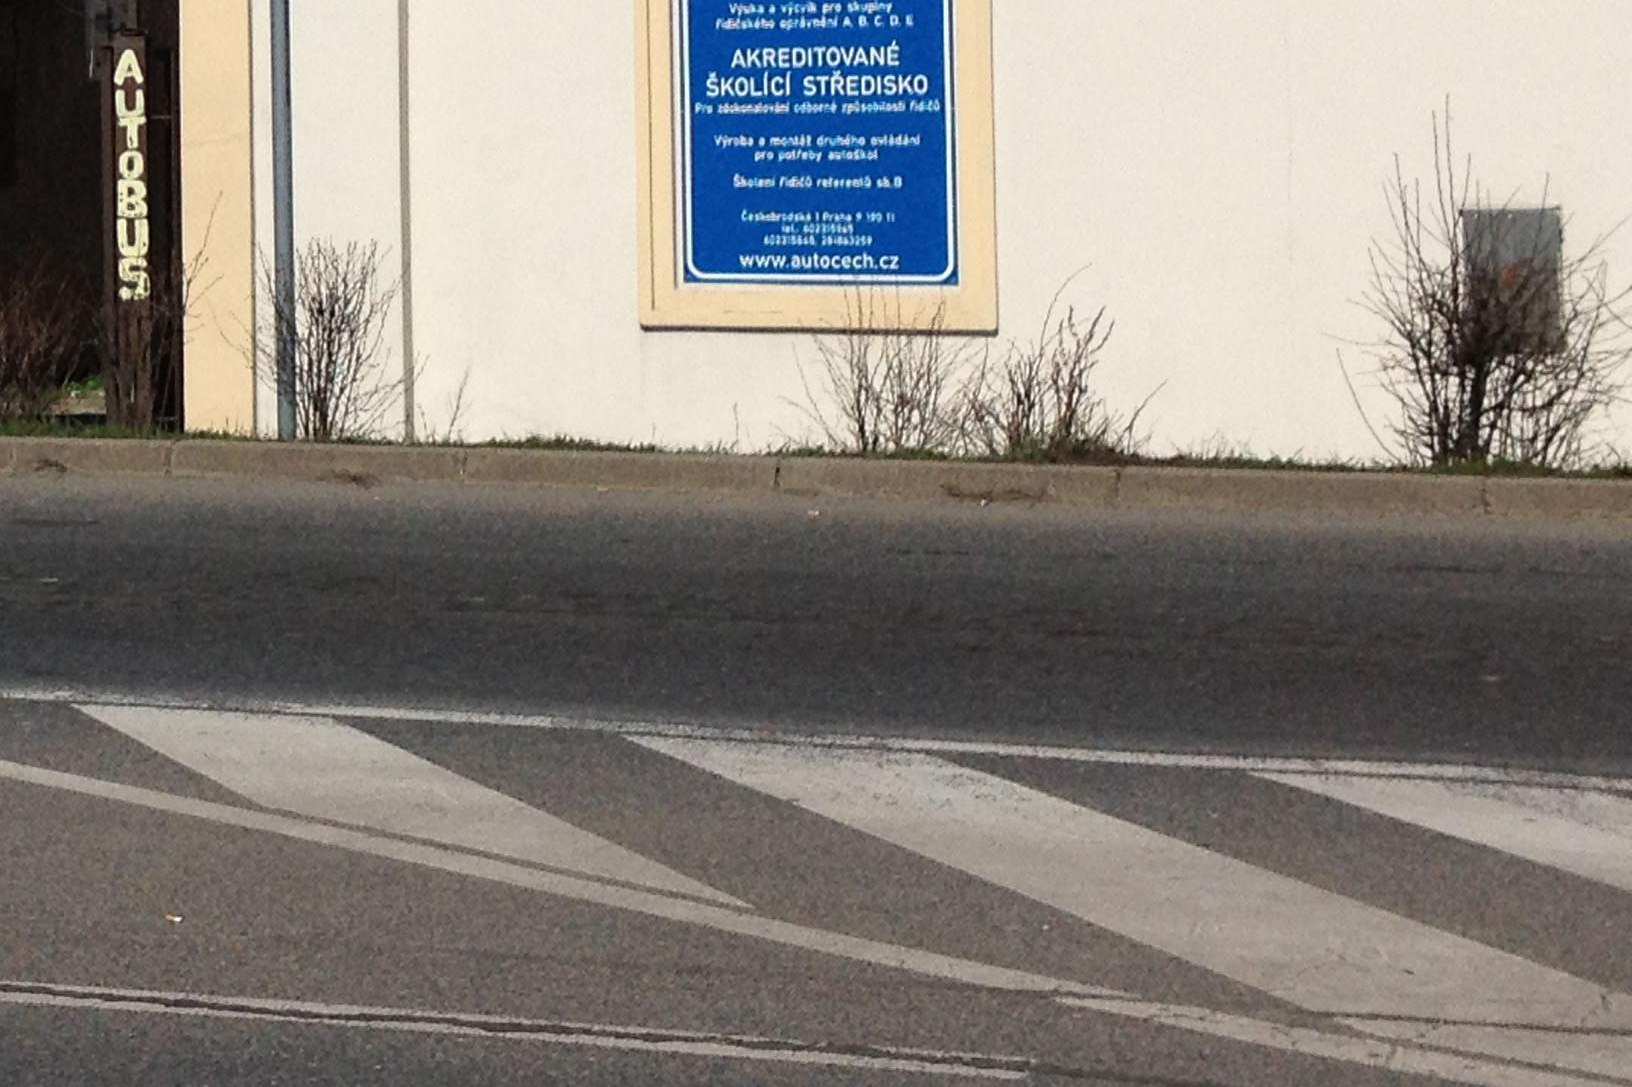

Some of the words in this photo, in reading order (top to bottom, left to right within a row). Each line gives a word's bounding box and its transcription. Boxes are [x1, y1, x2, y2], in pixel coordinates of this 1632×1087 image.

[768, 5, 776, 14] a
[822, 4, 842, 16] pro
[847, 1, 893, 16] skupiny
[731, 40, 901, 68] AKREDITOVANÉ
[706, 70, 791, 97] ŠKOLÍCÍ
[802, 70, 929, 96] STŘEDISKO
[695, 102, 713, 114] Pro
[714, 134, 755, 149] Výroba
[758, 137, 766, 146] a
[816, 133, 866, 147] druhého
[870, 132, 921, 146] ovládání
[754, 149, 774, 162] pro
[778, 148, 823, 162] potřeby
[114, 49, 150, 300] AUTOBUS
[822, 212, 853, 222] Praha
[739, 253, 900, 270] www.autocech.cz
